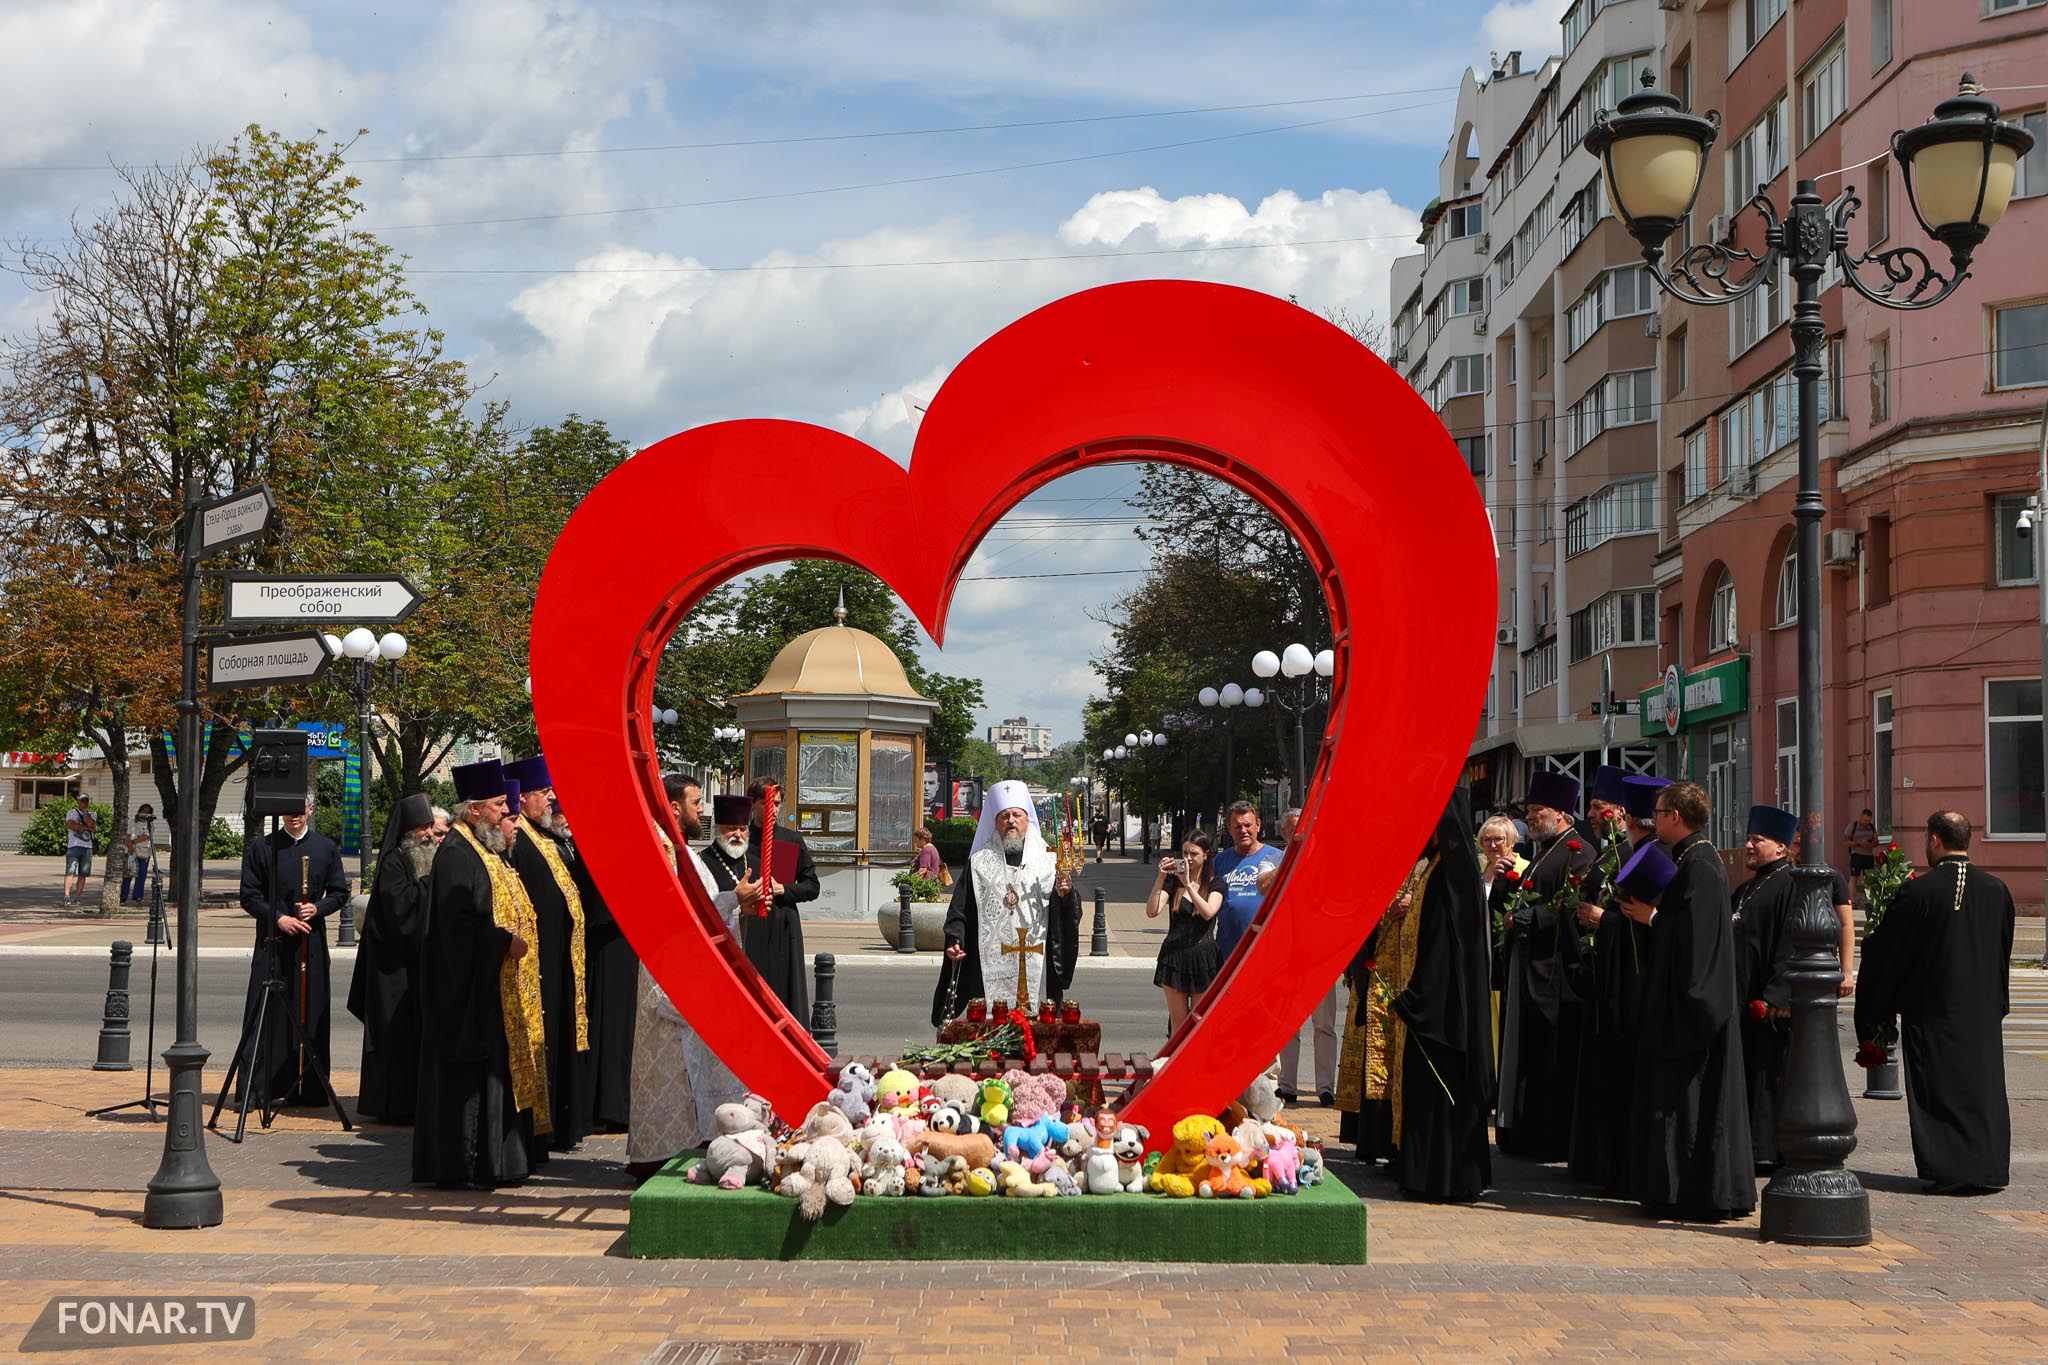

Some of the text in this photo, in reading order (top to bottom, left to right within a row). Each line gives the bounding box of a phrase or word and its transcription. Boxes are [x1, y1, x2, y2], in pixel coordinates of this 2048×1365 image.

[205, 513, 220, 527] Стела
[238, 497, 264, 517] воинской
[260, 585, 382, 600] Преображенский
[299, 600, 342, 615] собор
[218, 651, 309, 670] Соборная площадь
[1223, 868, 1258, 887] Vintage
